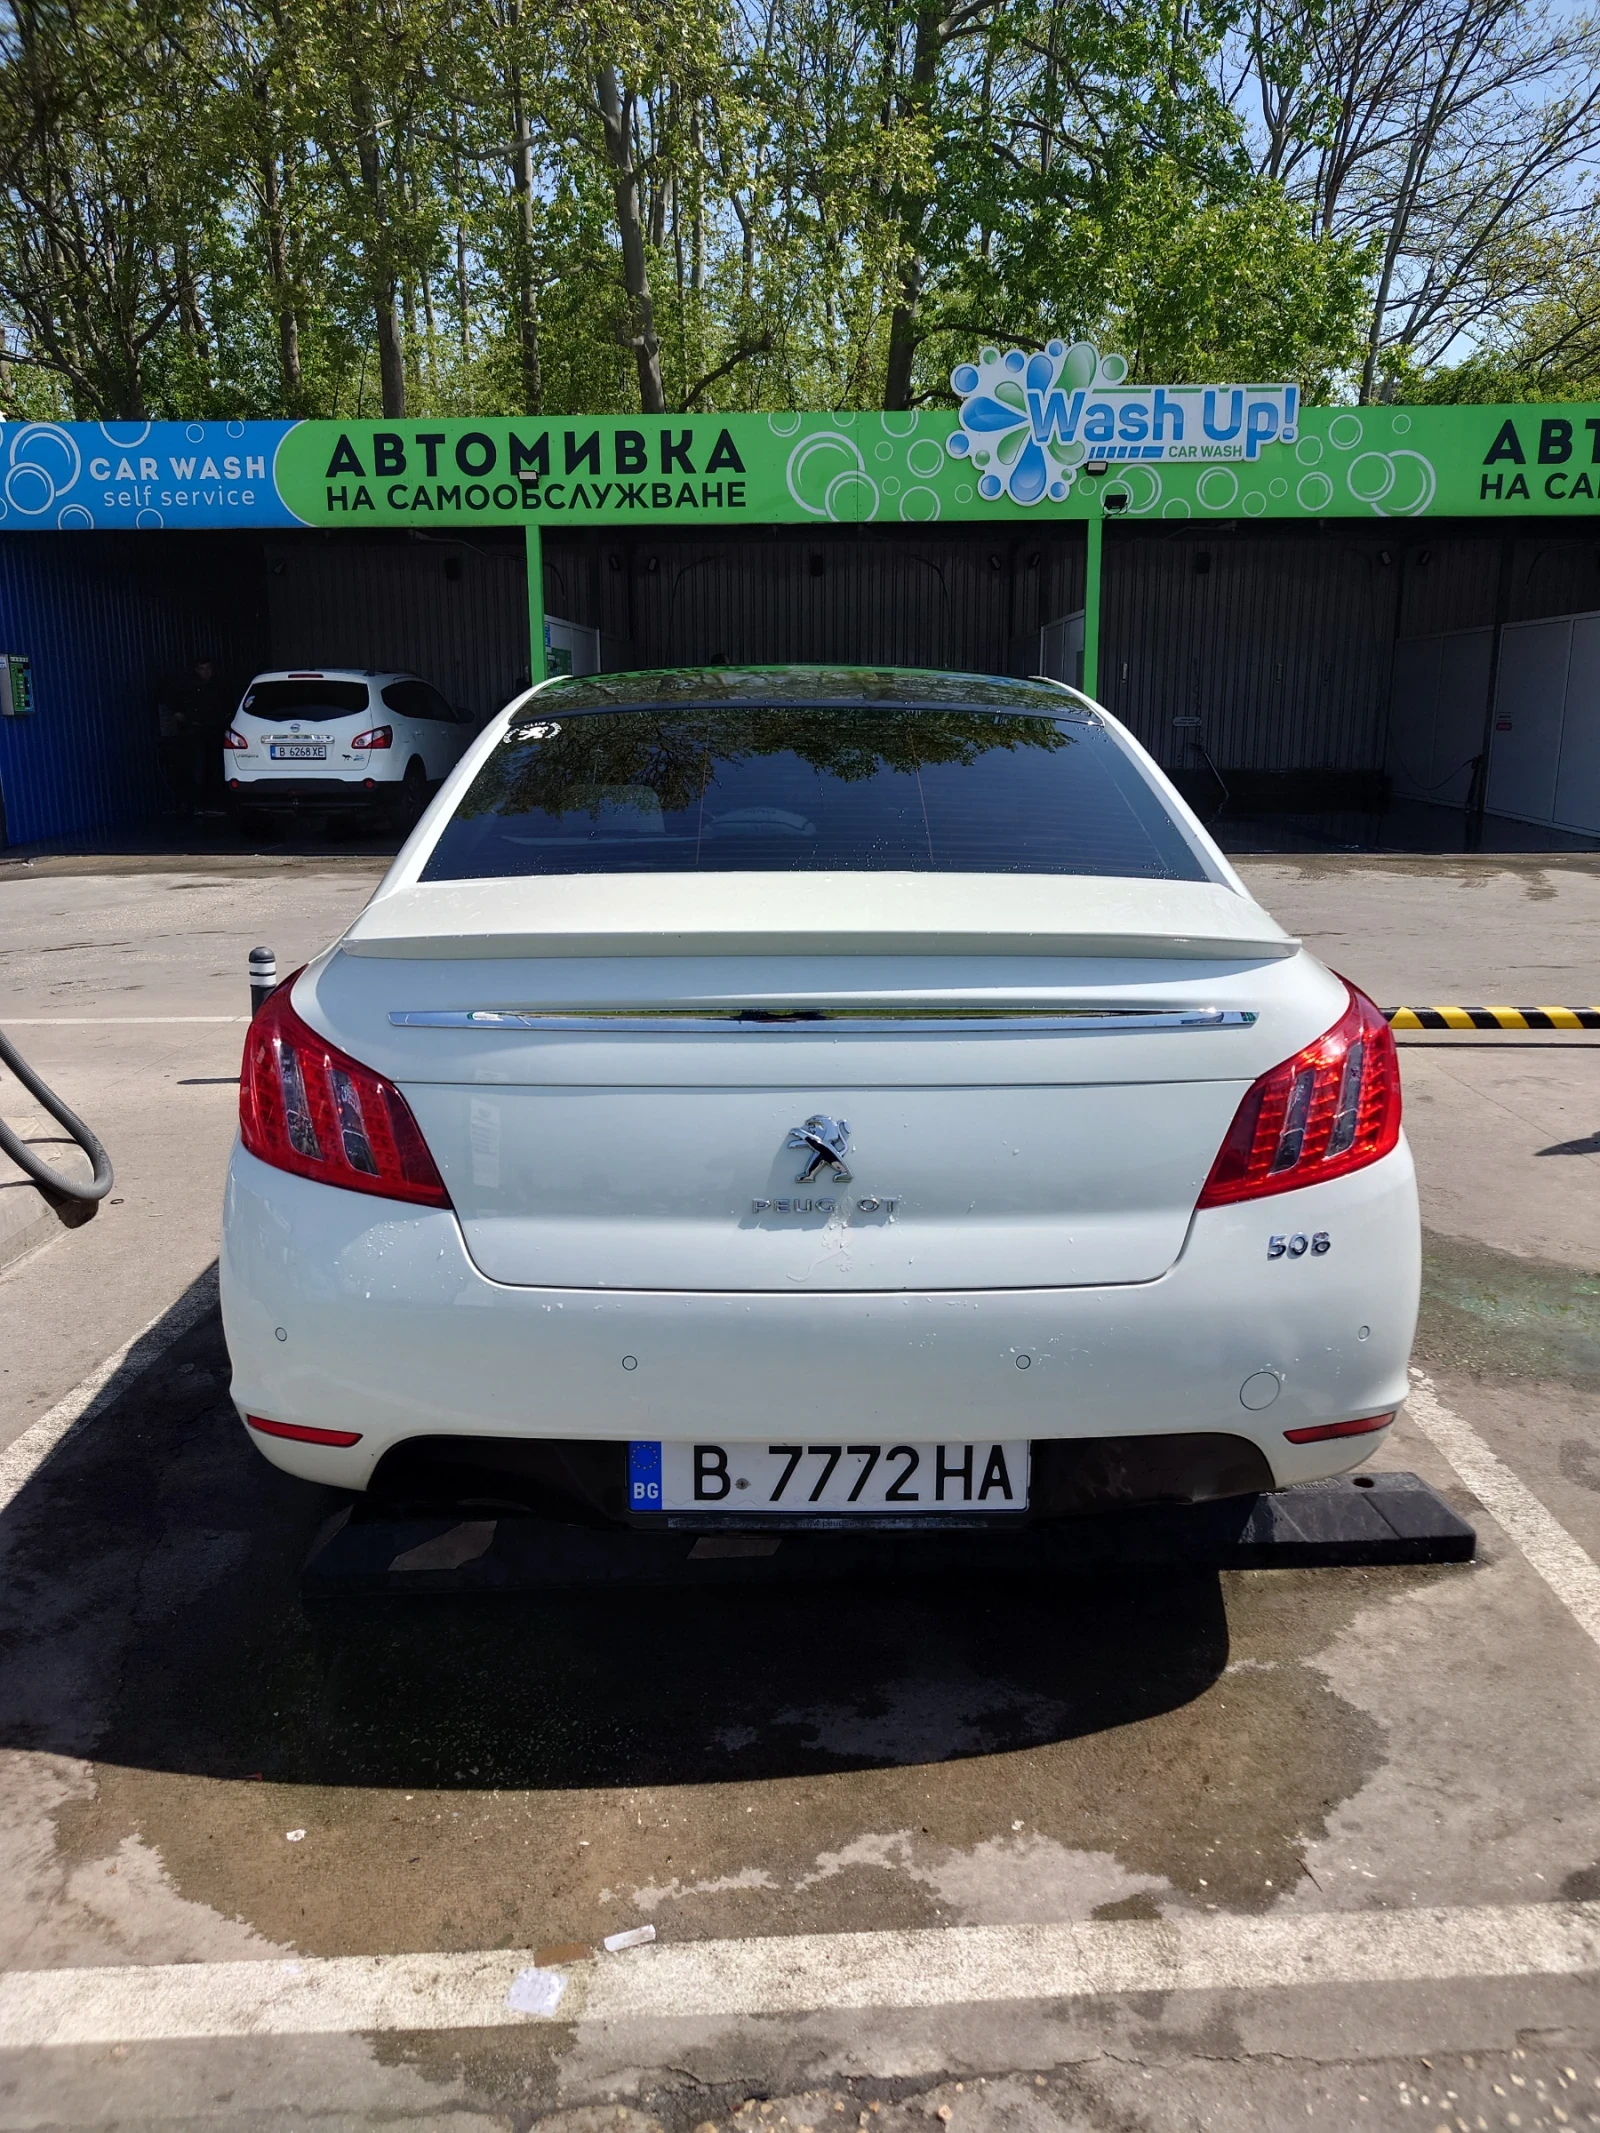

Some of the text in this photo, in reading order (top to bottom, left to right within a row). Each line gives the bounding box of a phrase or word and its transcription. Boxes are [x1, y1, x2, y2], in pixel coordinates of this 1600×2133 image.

[1027, 387, 1297, 458] Wash Up!
[325, 428, 747, 477] АВТОМИВКА
[1168, 445, 1242, 458] CAR WASH
[89, 455, 266, 481] CAR WASH
[103, 484, 255, 507] self service
[326, 481, 747, 511] НА САМООБСЛУЖВАНЕ
[1480, 472, 1600, 500] НА СА
[1267, 1231, 1331, 1258] 508
[768, 1445, 920, 1502] 7772
[633, 1482, 659, 1499] BG
